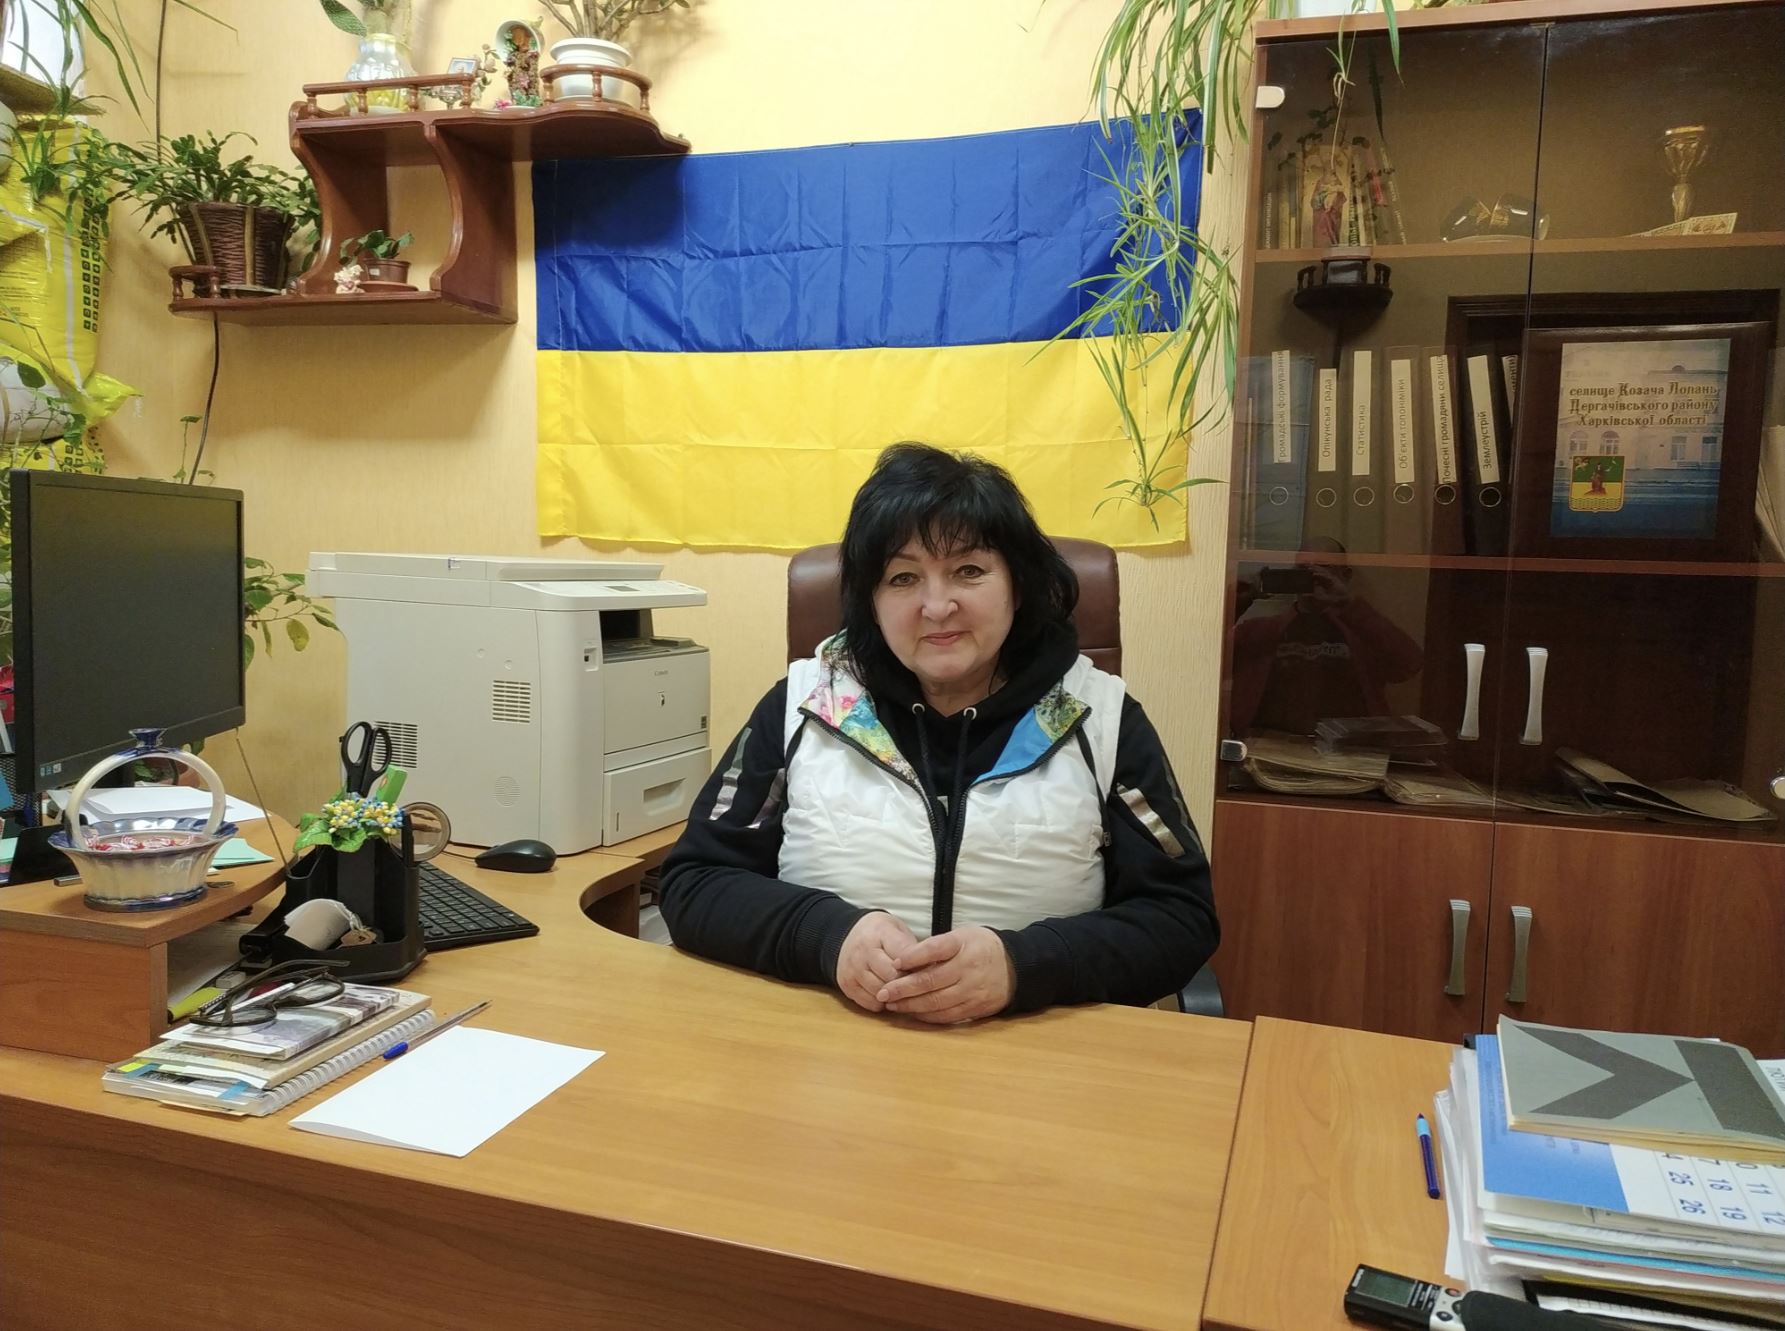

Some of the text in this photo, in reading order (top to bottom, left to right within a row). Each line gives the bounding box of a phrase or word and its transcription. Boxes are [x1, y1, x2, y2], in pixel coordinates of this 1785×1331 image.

[1569, 386, 1615, 398] селище
[1618, 382, 1664, 397] Козача
[1569, 399, 1669, 414] Дергачівського
[1321, 379, 1333, 458] Опікунська рада
[1439, 393, 1452, 445] громадяни
[1577, 413, 1707, 427] Харківської області
[1356, 405, 1366, 456] Статистика
[1477, 411, 1492, 470] Землеустрій
[1668, 1171, 1694, 1186] 25
[1746, 1184, 1773, 1194] 11
[1678, 1198, 1706, 1215] 26
[1707, 1179, 1733, 1191] 18
[1720, 1207, 1747, 1220] 19
